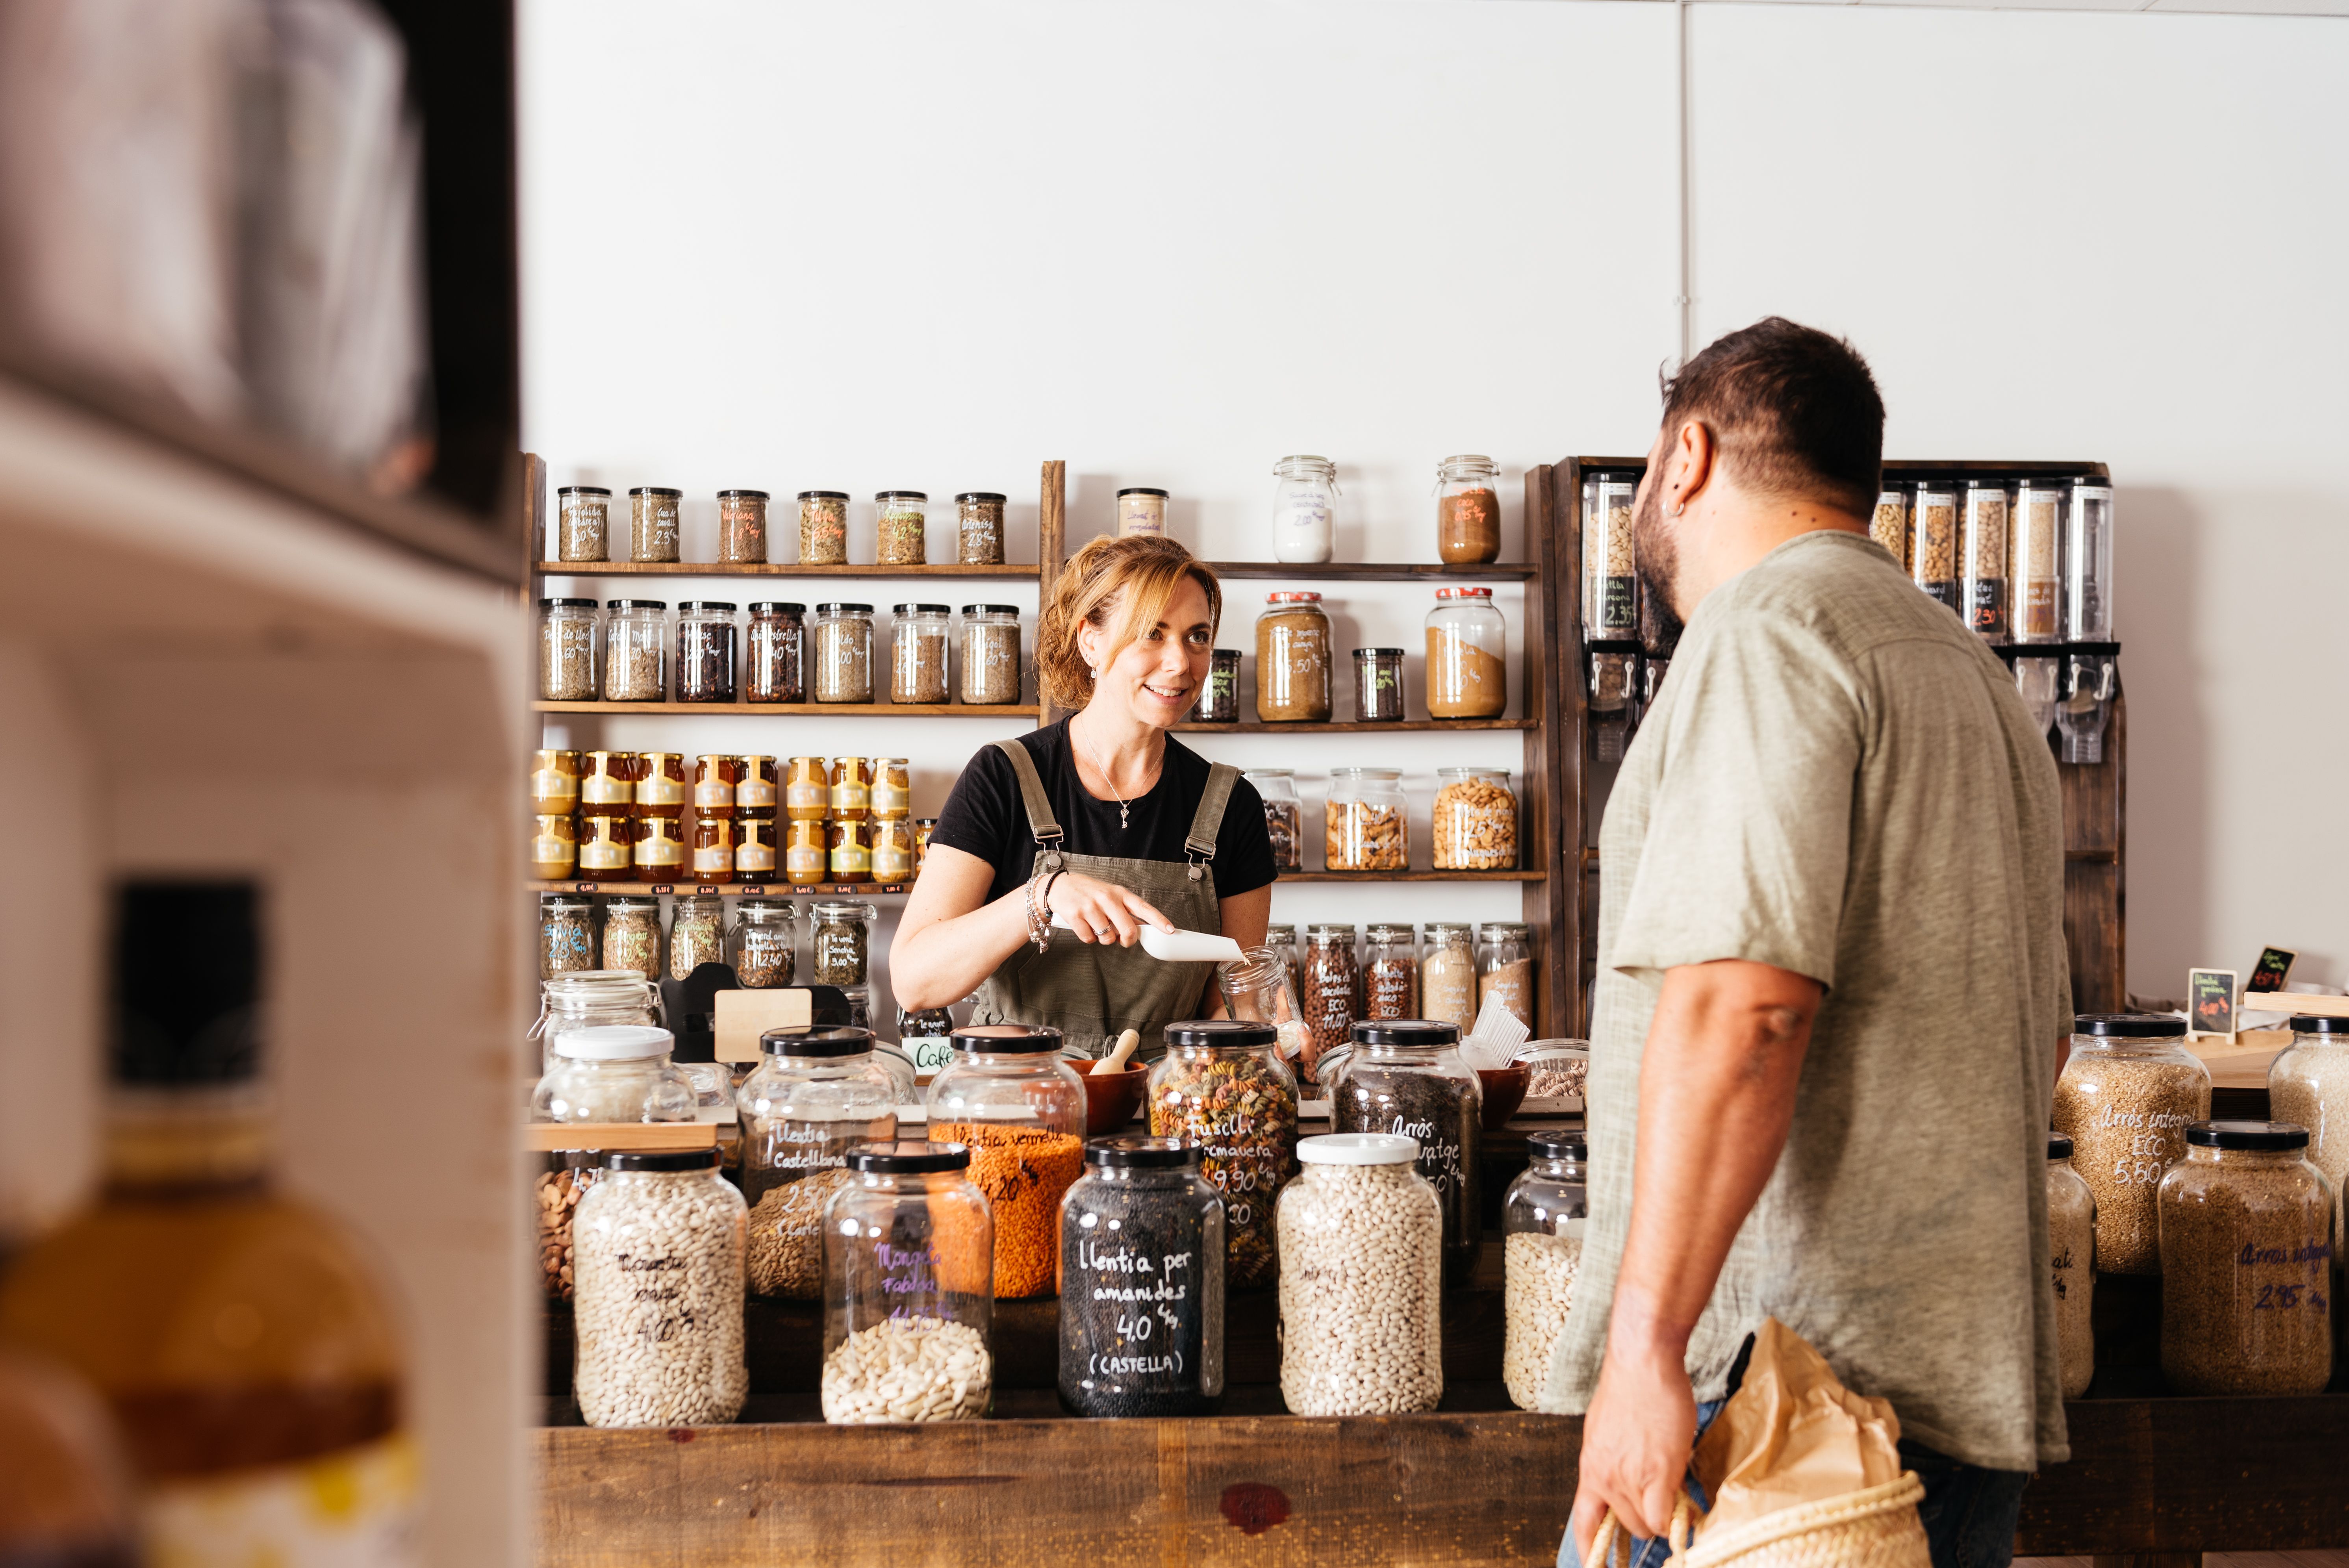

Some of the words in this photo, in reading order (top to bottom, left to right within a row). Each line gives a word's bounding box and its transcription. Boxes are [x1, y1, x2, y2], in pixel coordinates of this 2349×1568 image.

[564, 629, 574, 639] de
[829, 945, 856, 955] Sencha
[1328, 999, 1346, 1012] ECO
[1187, 1113, 1254, 1137] Fusilli
[1203, 1145, 1274, 1157] rimavera
[2132, 1138, 2165, 1157] ECO
[2114, 1164, 2161, 1186] 5,50
[1228, 1205, 1251, 1225] CO
[874, 1242, 942, 1271] Mongeta
[1163, 1251, 1192, 1283] per
[1093, 1278, 1186, 1302] amanides
